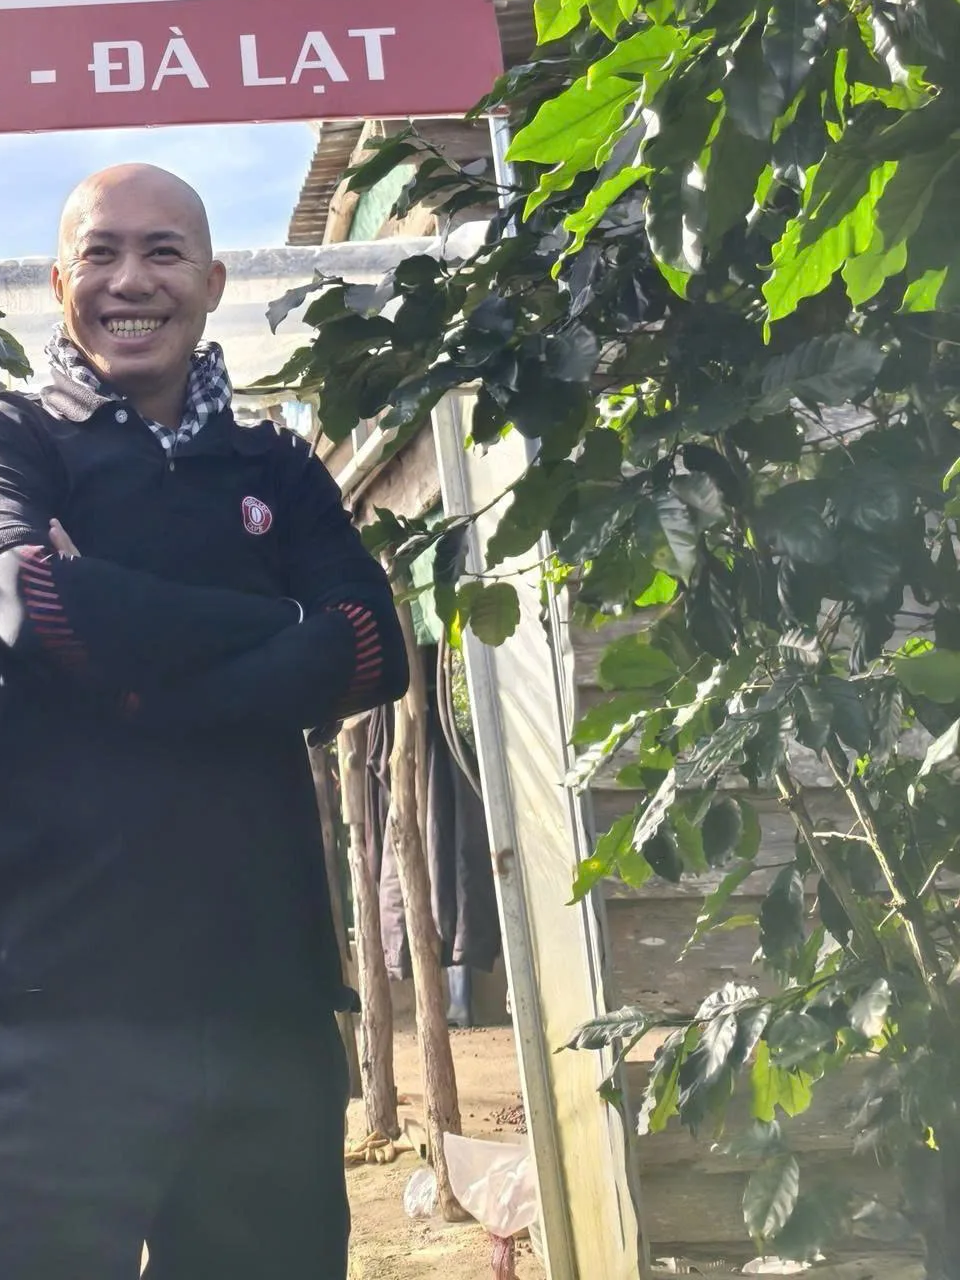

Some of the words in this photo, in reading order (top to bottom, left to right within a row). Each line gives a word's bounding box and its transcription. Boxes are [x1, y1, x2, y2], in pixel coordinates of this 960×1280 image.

[30, 69, 57, 84] -
[87, 26, 210, 93] ĐÀ
[239, 27, 397, 94] LẠT
